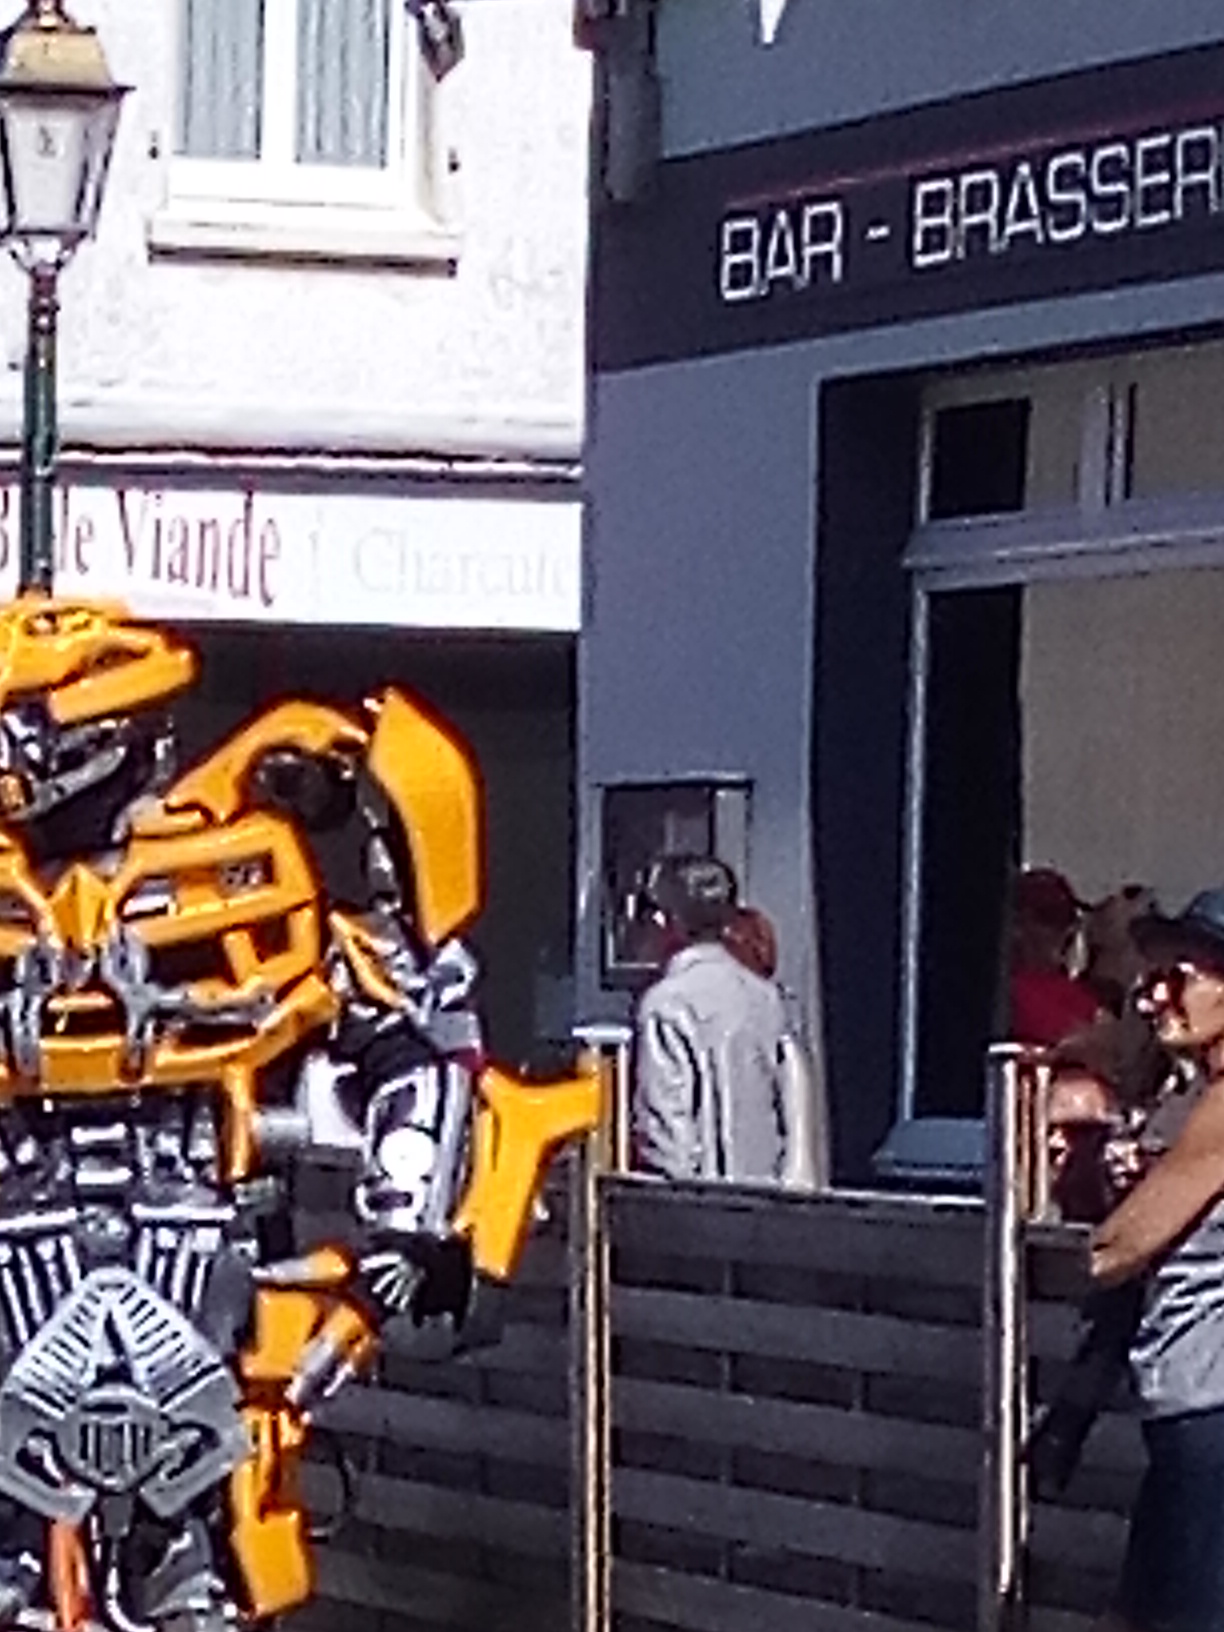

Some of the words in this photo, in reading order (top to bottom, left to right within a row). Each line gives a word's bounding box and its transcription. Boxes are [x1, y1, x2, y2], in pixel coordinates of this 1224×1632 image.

[719, 199, 844, 300] BAR
[911, 126, 1224, 268] BRASSER
[116, 478, 281, 608] Viande
